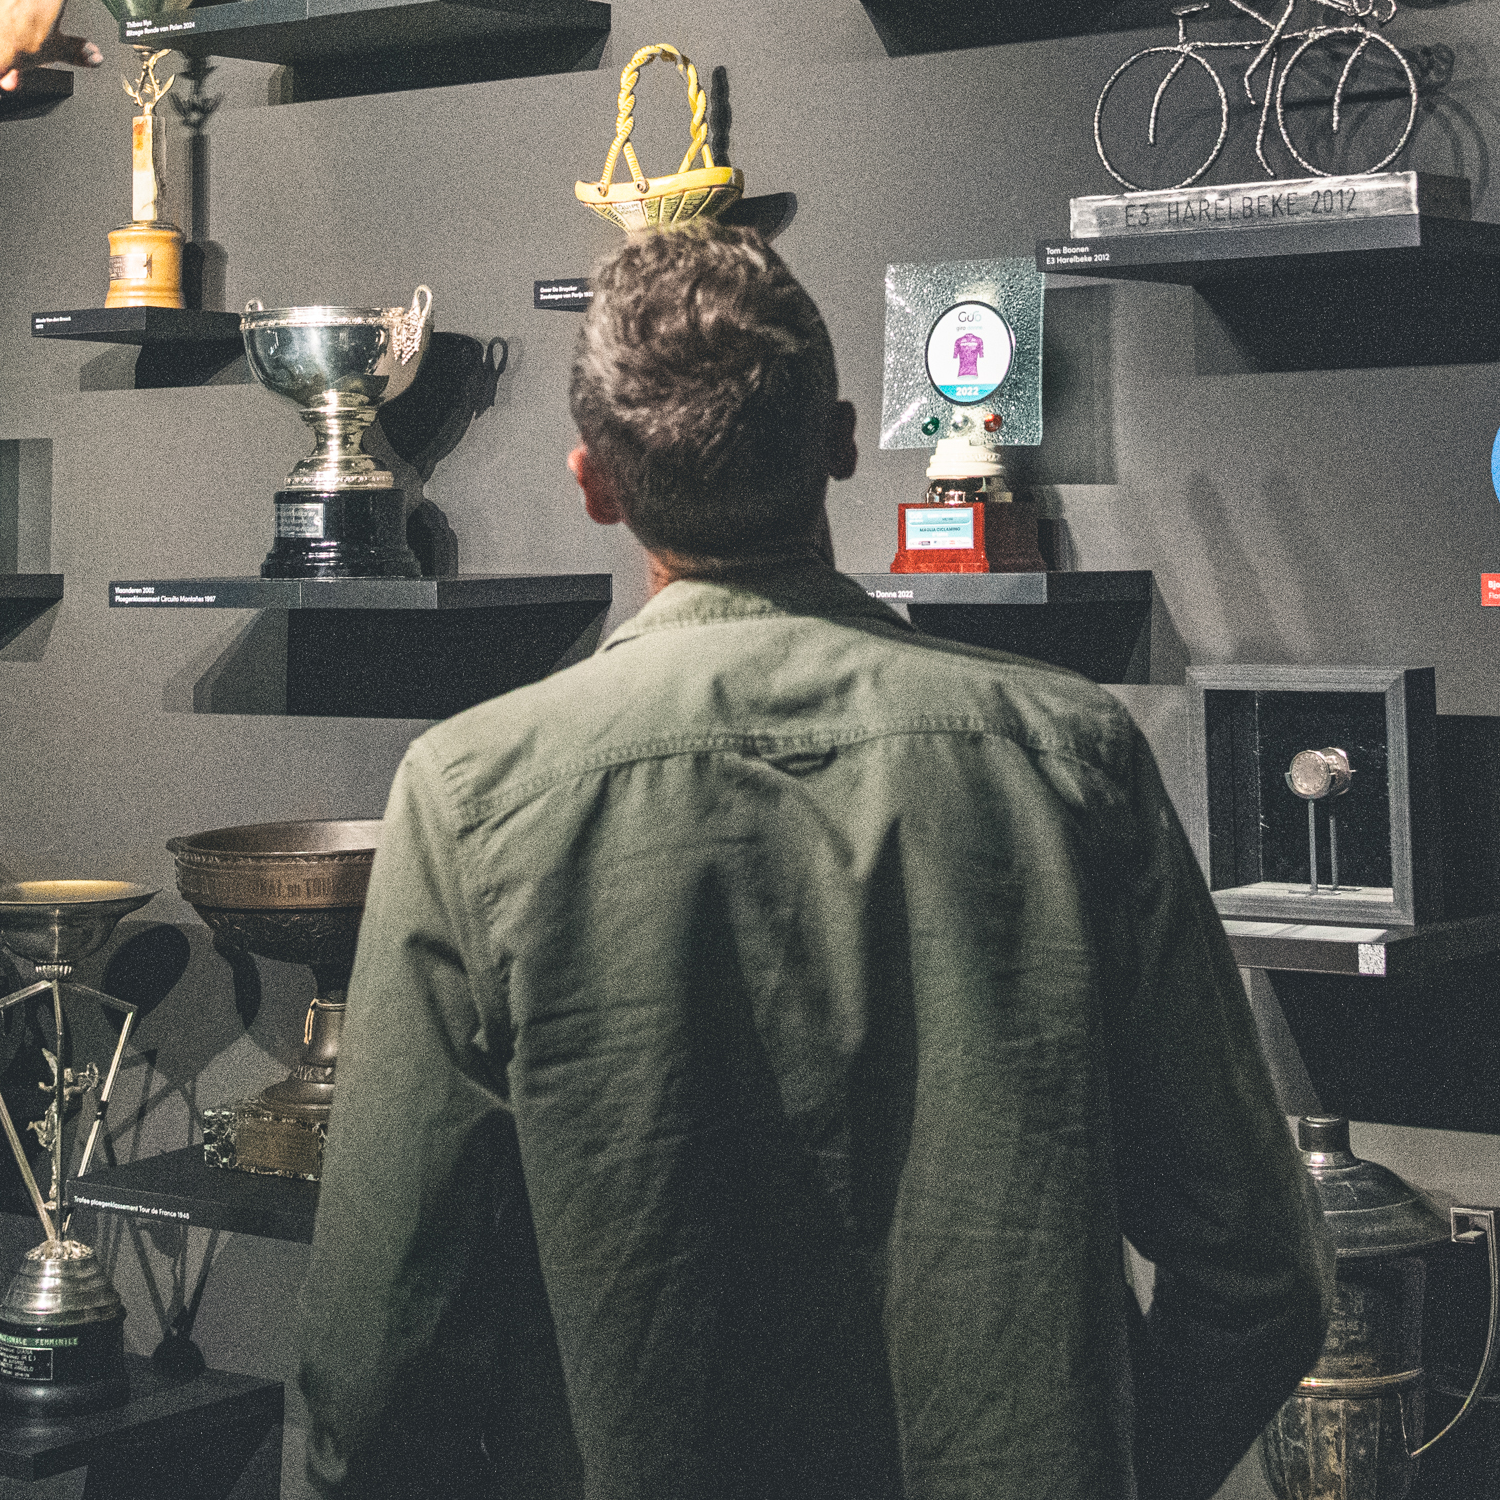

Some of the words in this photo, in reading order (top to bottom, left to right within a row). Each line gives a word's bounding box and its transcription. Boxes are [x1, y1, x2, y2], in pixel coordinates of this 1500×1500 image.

[1124, 203, 1150, 227] E3
[1167, 193, 1301, 223] HARELBEKE
[1311, 187, 1358, 214] 2012
[1062, 245, 1090, 254] Boonen
[1046, 256, 1055, 265] E3
[1056, 255, 1092, 264] Harelbeke
[1093, 253, 1110, 262] 2012
[955, 386, 979, 396] 2022
[875, 589, 897, 598] Donne
[897, 589, 914, 598] 2022
